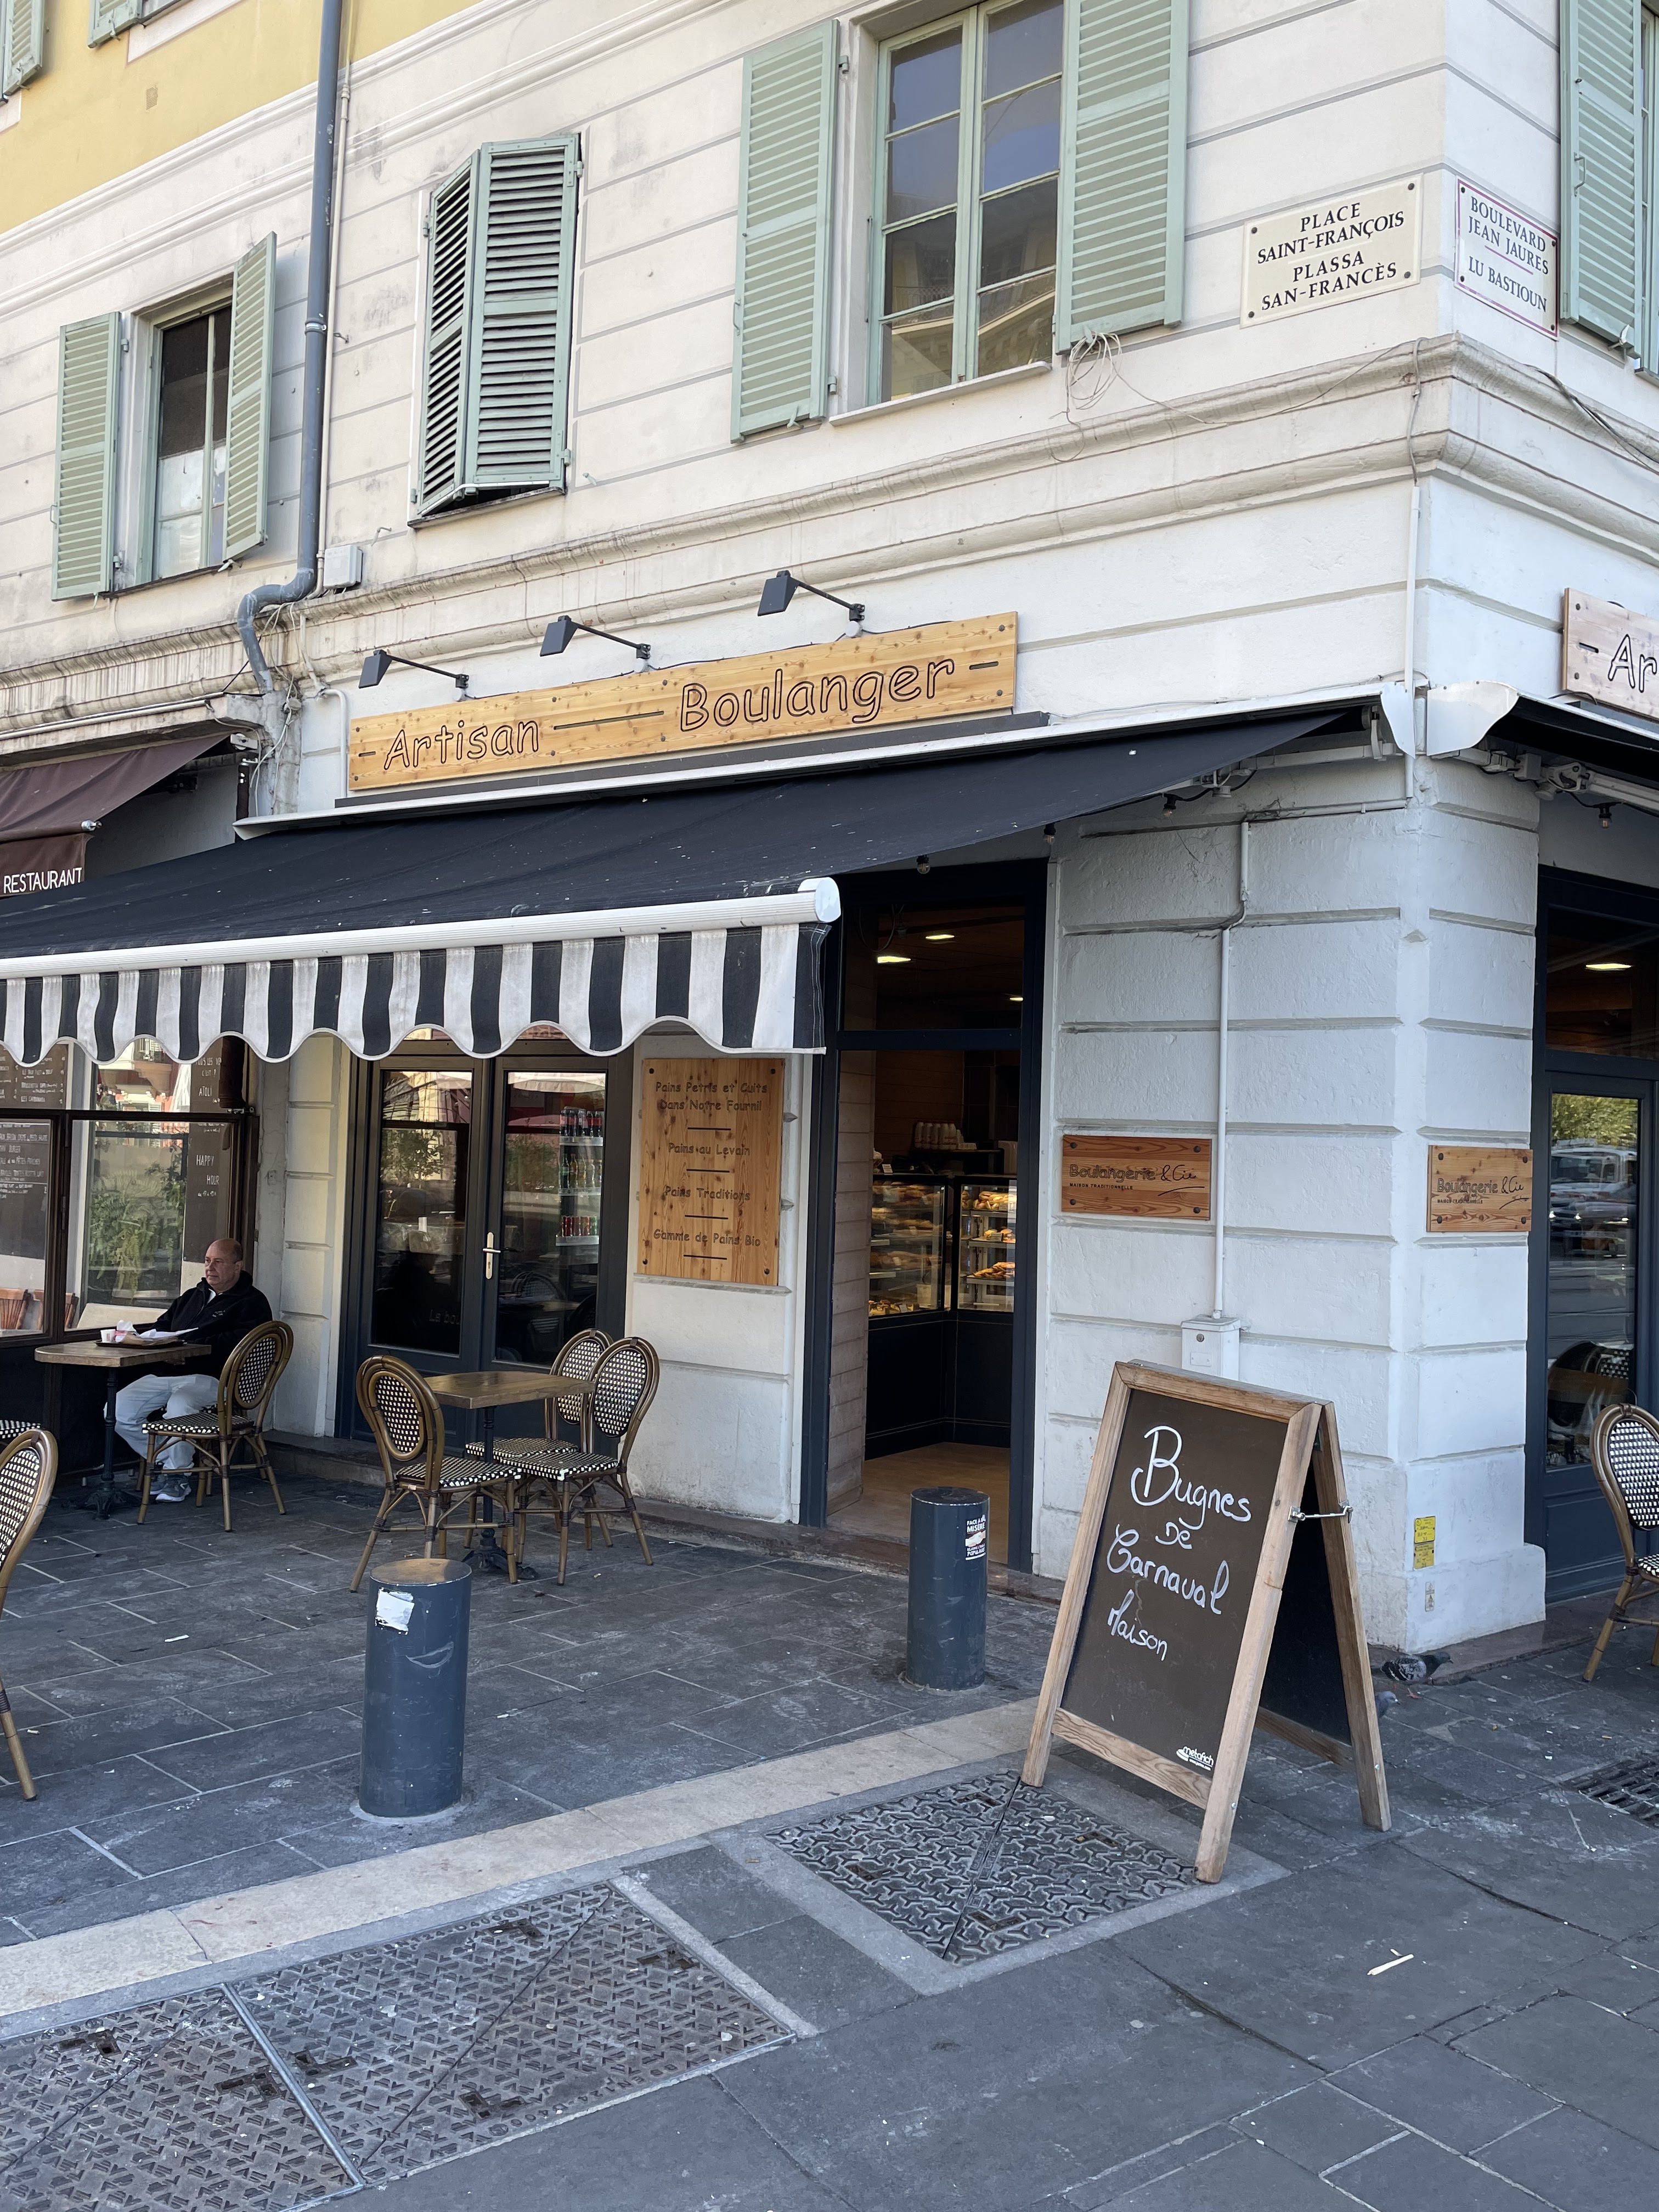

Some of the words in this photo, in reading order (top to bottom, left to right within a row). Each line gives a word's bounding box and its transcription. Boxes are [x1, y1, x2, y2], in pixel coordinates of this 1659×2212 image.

[1300, 202, 1361, 233] PLACE
[1471, 197, 1546, 252] BOULEVARD
[1257, 211, 1404, 264] SAINT-FRANÇOIS
[1468, 216, 1500, 247] JEAN
[1505, 238, 1549, 275] JAURES
[1293, 251, 1365, 282] PLASSA
[1262, 262, 1397, 311] SAN-FRANCÈS
[1469, 256, 1484, 276] LU
[1488, 267, 1547, 313] BASTIOUN
[383, 719, 539, 770] Artisan
[680, 658, 955, 732] Boulanger
[3, 867, 82, 894] RESTAURANT
[196, 1057, 206, 1065] OUS
[656, 1081, 681, 1092] Pains
[723, 1083, 735, 1093] et
[741, 1082, 768, 1093] Cuits
[660, 1099, 685, 1110] Dans
[690, 1099, 721, 1110] Notre
[726, 1099, 763, 1111] Fournil
[196, 1155, 215, 1166] HAPPY
[668, 1142, 694, 1153] Pains
[699, 1146, 712, 1155] au
[716, 1144, 751, 1155] Levain
[206, 1175, 219, 1186] HOUR
[1069, 1164, 1156, 1183] Boulangerie
[1437, 1177, 1499, 1197] Boulangerie
[665, 1186, 691, 1198] Pains
[696, 1187, 752, 1201] Traditions
[653, 1228, 690, 1242] Gamme
[695, 1231, 708, 1243] de
[713, 1232, 740, 1245] Pains
[745, 1235, 761, 1247] Bio
[1131, 1425, 1252, 1530] Bugnes
[1106, 1523, 1231, 1615] Carnaval
[1107, 1589, 1168, 1661] Maison
